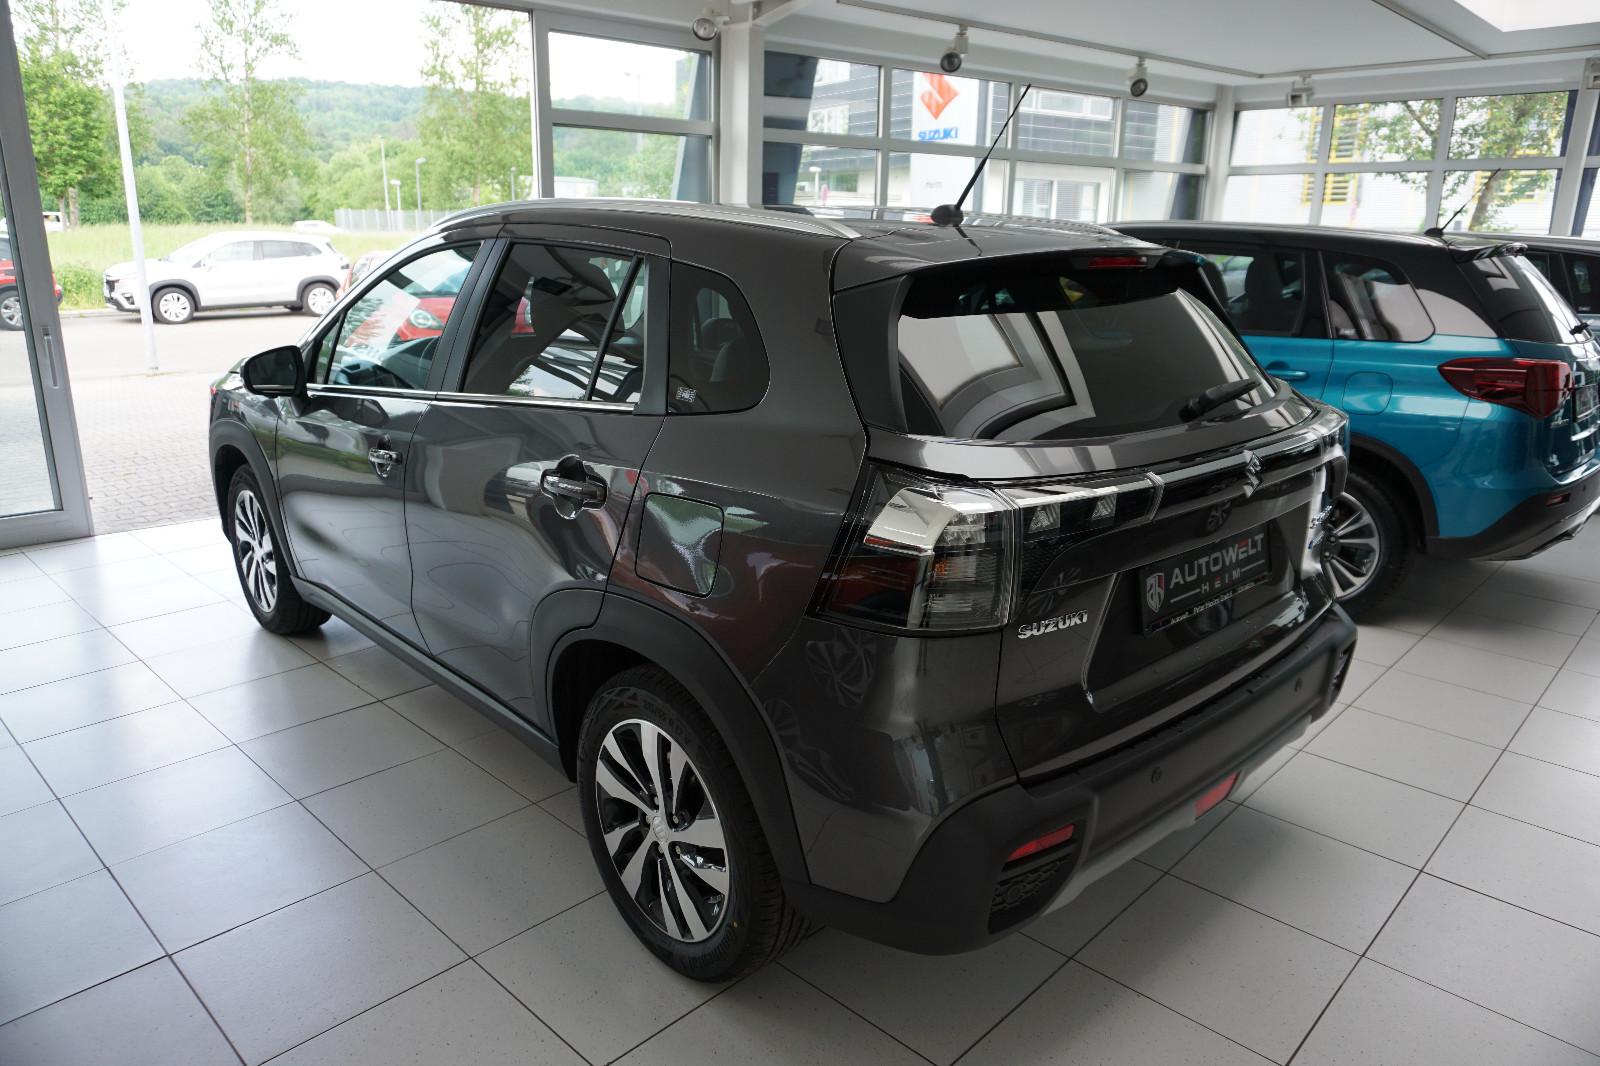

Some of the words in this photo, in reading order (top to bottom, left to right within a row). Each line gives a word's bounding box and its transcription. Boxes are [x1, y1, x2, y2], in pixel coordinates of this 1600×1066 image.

[918, 127, 959, 142] SUZUKI
[1169, 533, 1265, 589] AUTOWELT
[1017, 609, 1089, 640] SUZUKI
